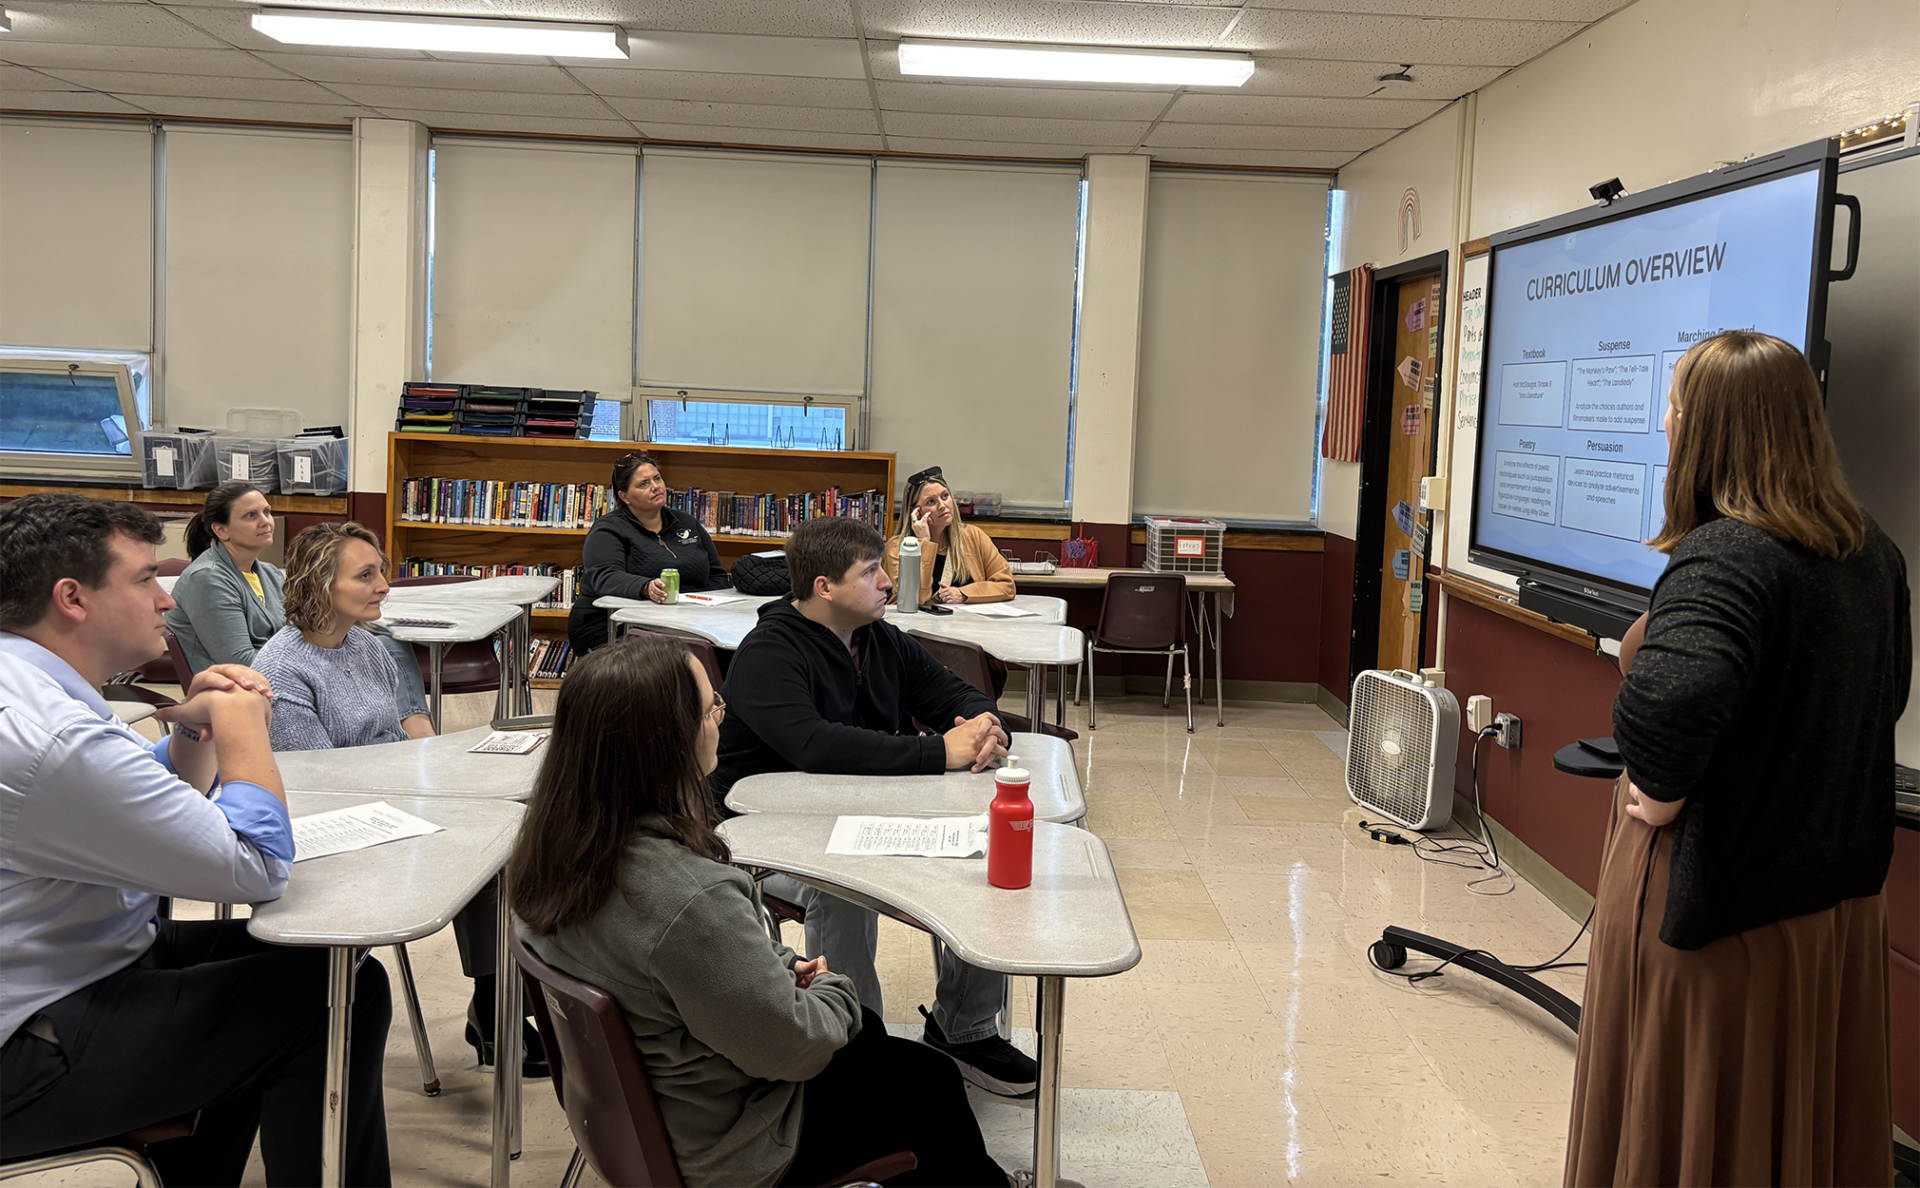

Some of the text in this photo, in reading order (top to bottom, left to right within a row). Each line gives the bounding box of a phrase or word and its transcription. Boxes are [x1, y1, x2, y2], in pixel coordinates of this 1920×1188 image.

[1526, 242, 1727, 301] CURRICULUM OVERVIEW
[1463, 287, 1482, 302] HEADER
[1598, 340, 1630, 353] Suspense
[1522, 348, 1546, 359] Textbook
[1519, 439, 1536, 451] Poetry
[1587, 440, 1623, 453] Persuasion
[1594, 470, 1612, 478] practice
[1612, 471, 1634, 481] rhetorical
[1567, 479, 1582, 487] devices
[1588, 482, 1604, 491] analyze
[1605, 484, 1639, 495] advertisements
[1595, 496, 1616, 504] speeches
